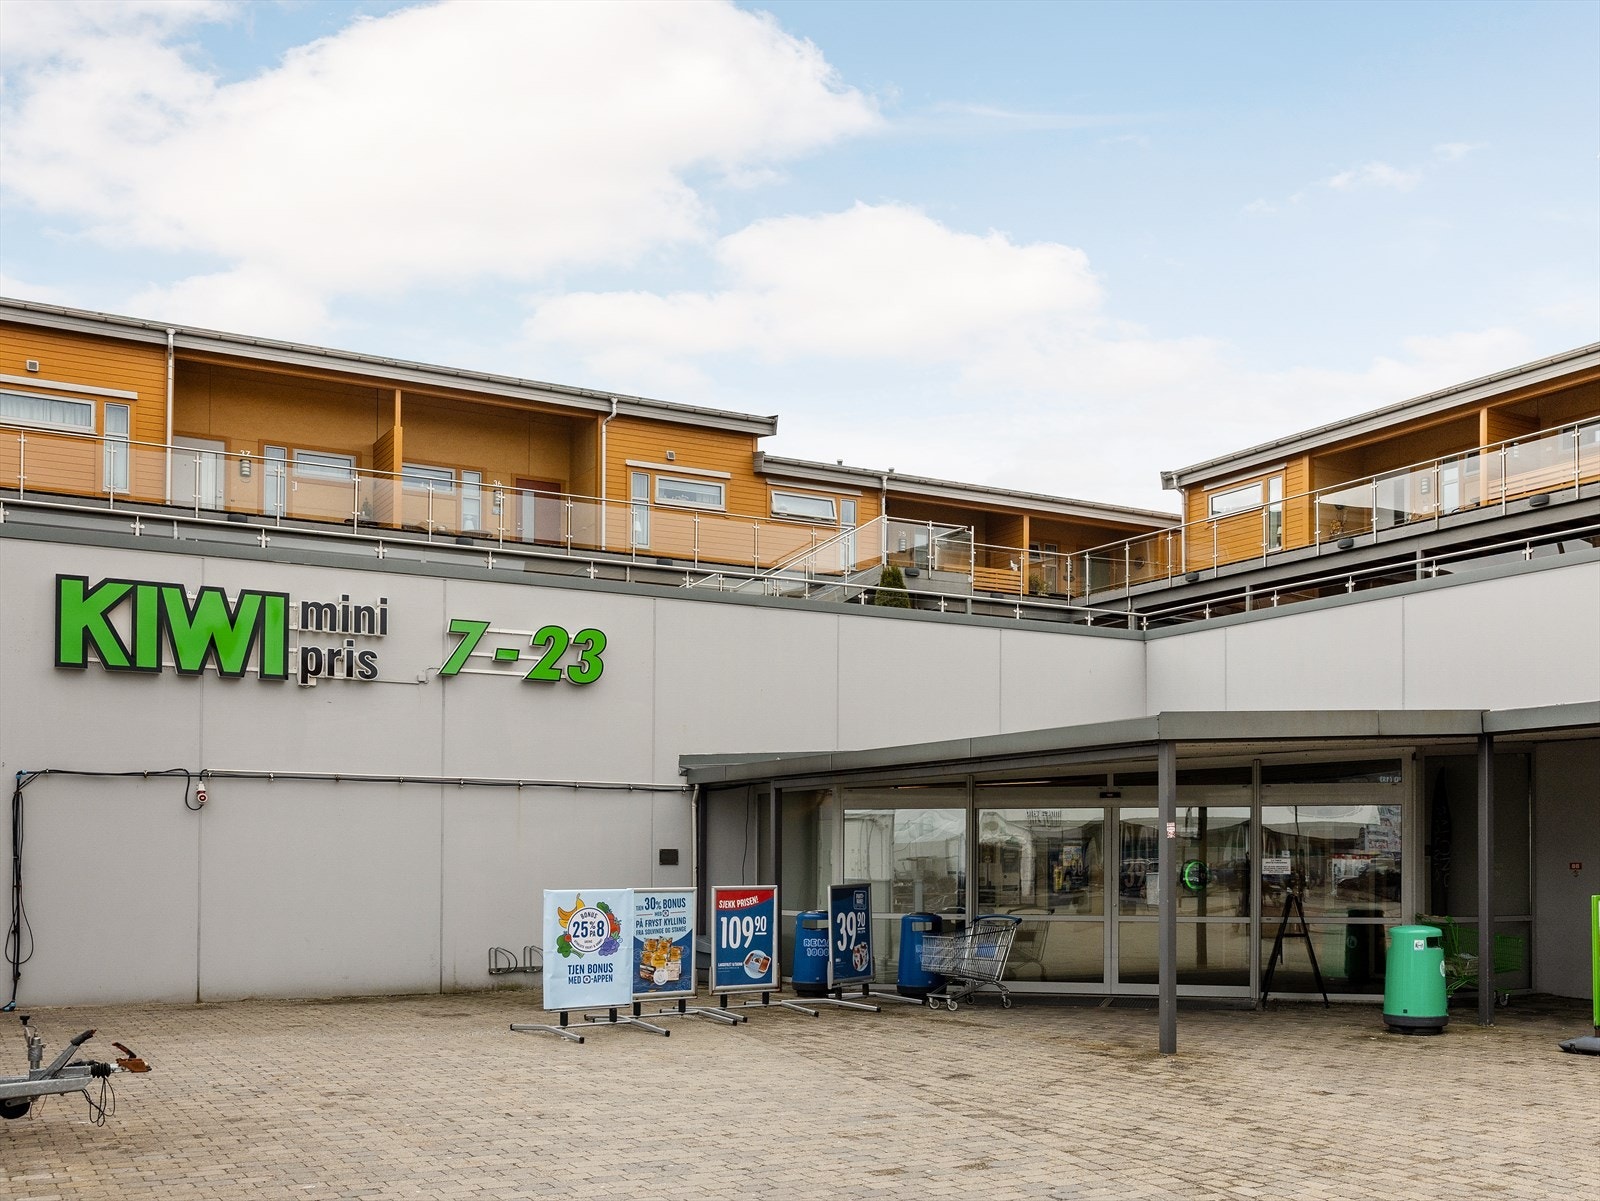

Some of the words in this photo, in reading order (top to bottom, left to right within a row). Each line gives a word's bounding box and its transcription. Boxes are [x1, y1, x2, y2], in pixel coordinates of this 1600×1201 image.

[300, 593, 389, 636] mini
[55, 573, 290, 680] KIWI
[438, 618, 492, 676] 7
[524, 624, 608, 685] 23
[300, 639, 380, 685] pris
[663, 898, 687, 909] BONUS
[719, 899, 736, 908] SJEKK
[737, 896, 759, 907] PRISEN!
[580, 911, 598, 919] BONUS
[636, 918, 644, 928] PÅ
[645, 919, 662, 928] FRYST
[664, 917, 687, 926] KYLLING
[572, 921, 588, 938] 25
[597, 920, 605, 937] 8
[720, 916, 754, 949] 109
[837, 912, 857, 951] 39
[803, 938, 829, 948] REM
[568, 964, 585, 975] TJEN
[588, 963, 614, 974] BONUS
[568, 976, 582, 984] MED
